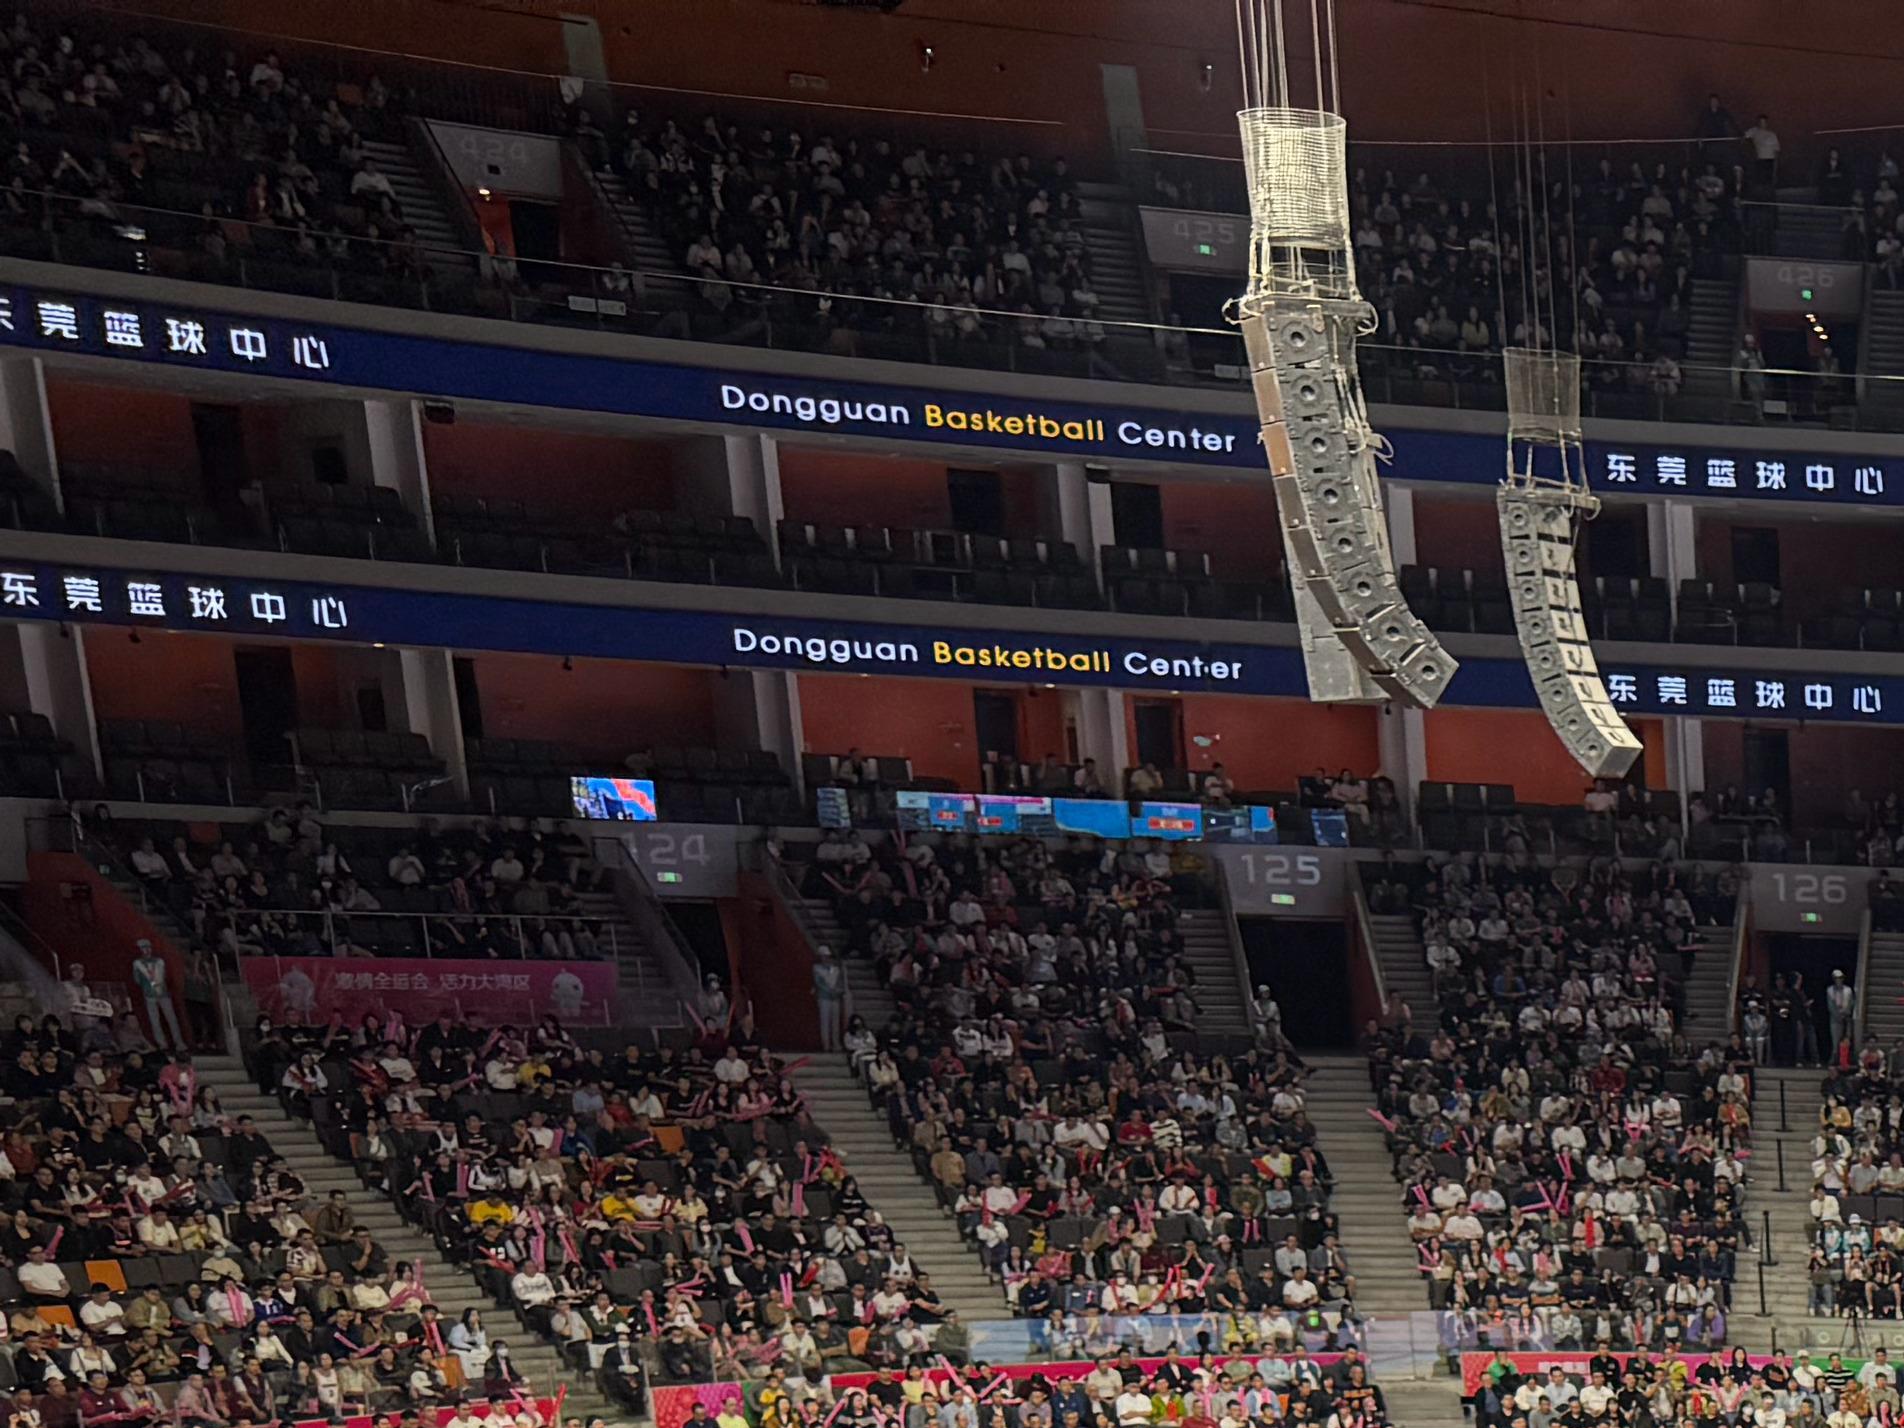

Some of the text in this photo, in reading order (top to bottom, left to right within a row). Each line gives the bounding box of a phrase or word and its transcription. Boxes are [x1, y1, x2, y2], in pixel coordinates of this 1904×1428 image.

[721, 385, 1236, 454] Dongguan Basketball Center
[1607, 454, 1885, 496] 东莞篮球中心
[2, 572, 348, 629] 东莞篮球中心
[734, 628, 1243, 681] Dongguan Basketball Center
[1608, 675, 1882, 714] 东莞篮球中心
[1242, 855, 1320, 886] 125
[1771, 873, 1844, 903] 126
